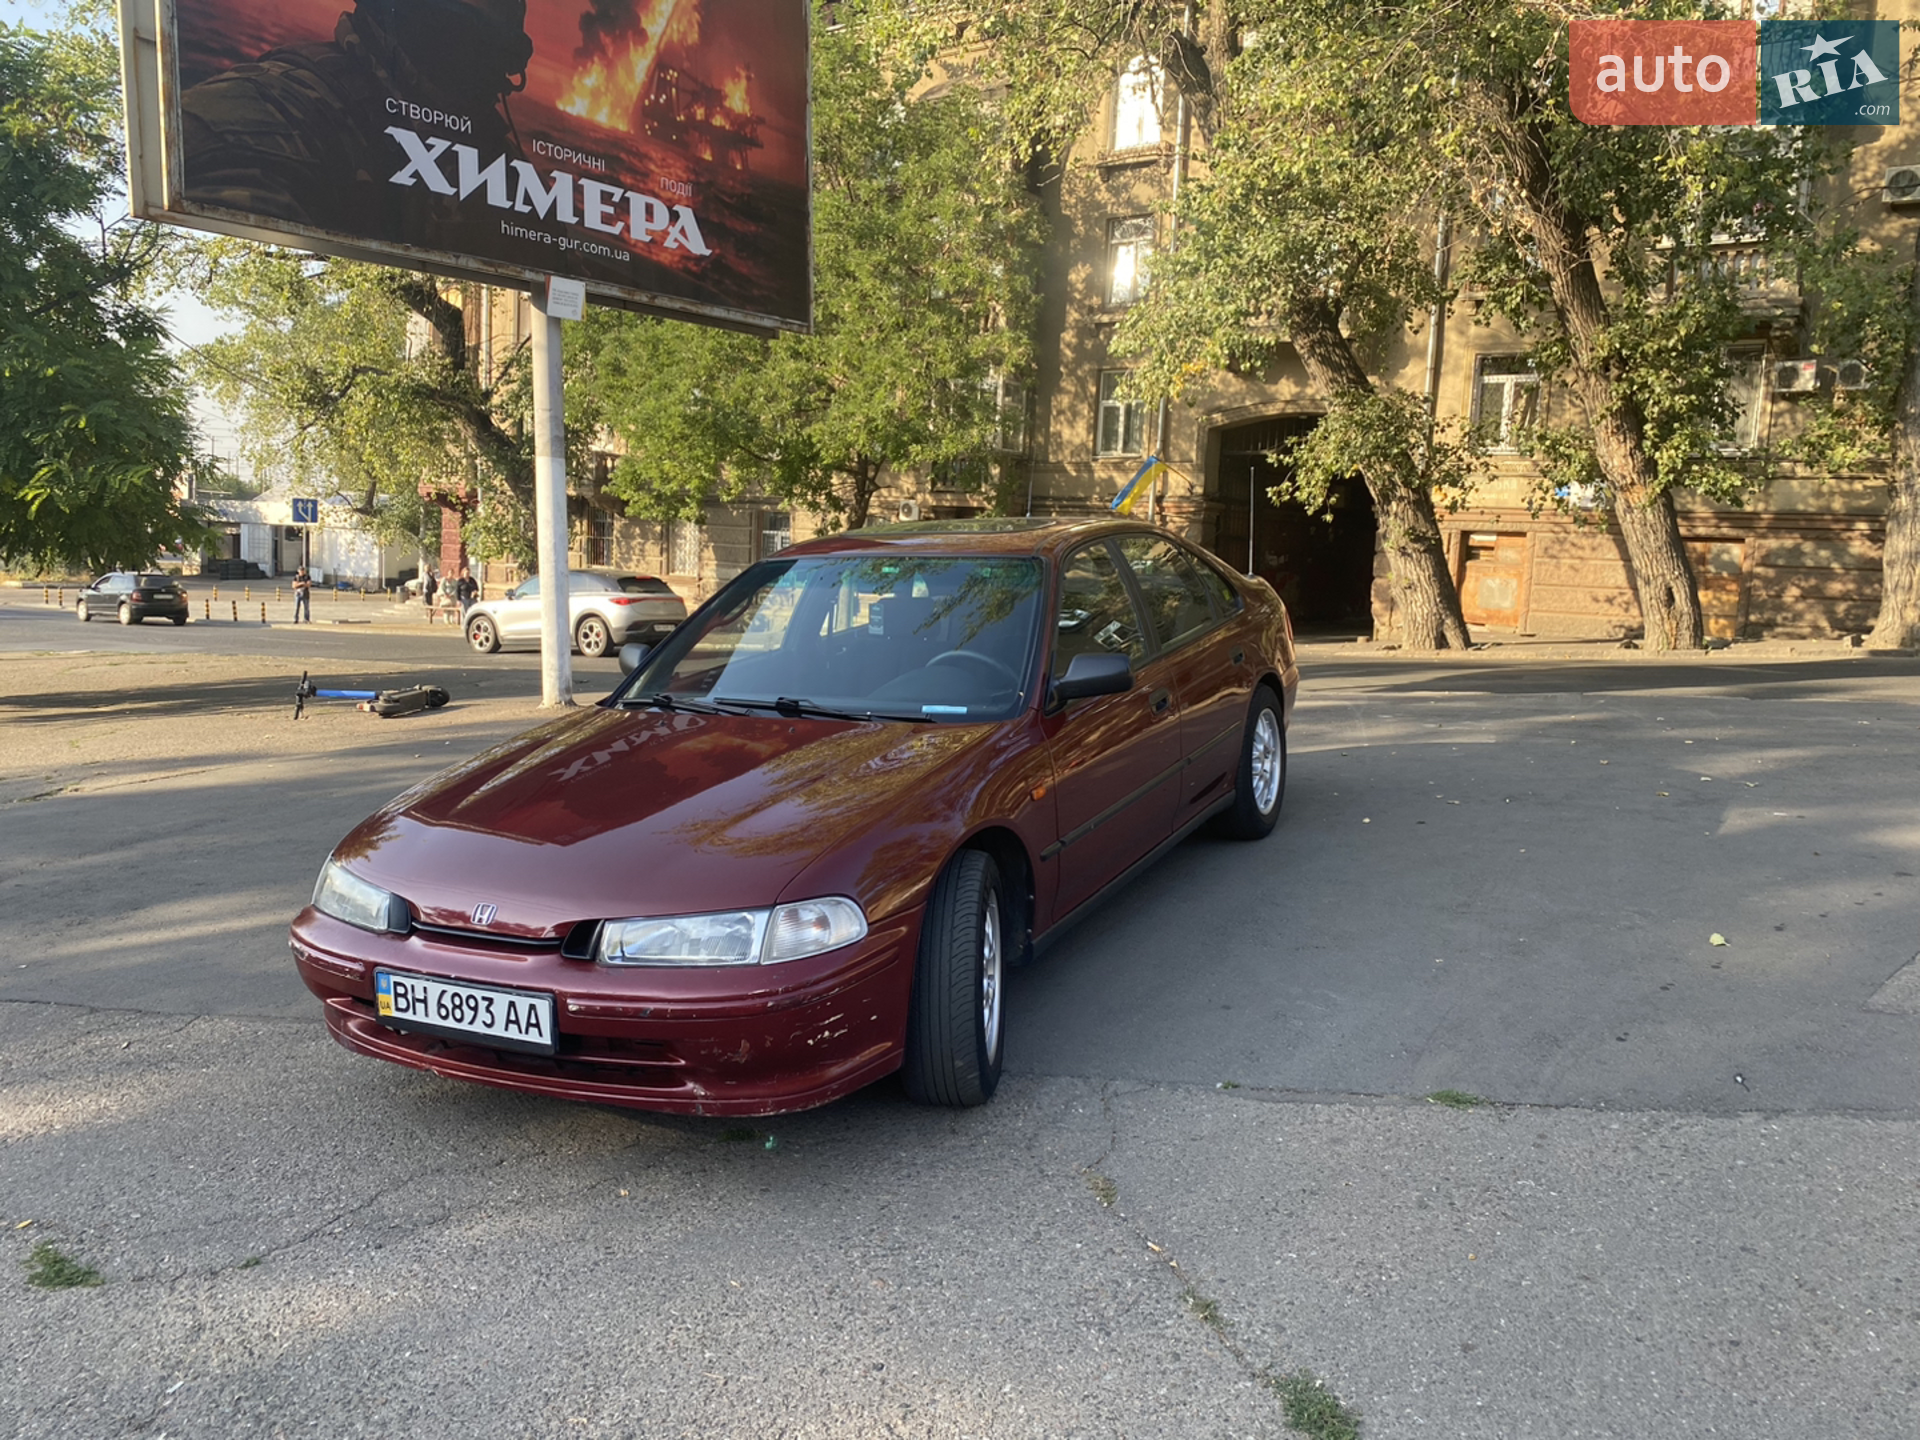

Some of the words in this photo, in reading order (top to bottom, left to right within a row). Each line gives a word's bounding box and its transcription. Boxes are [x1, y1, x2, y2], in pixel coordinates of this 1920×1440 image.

[385, 97, 472, 134] СТВОРЮЙ
[532, 139, 606, 172] ІСТОРИЧНІ
[384, 126, 713, 256] ХИМЕРА
[660, 176, 694, 198] ПОДІЇ
[501, 220, 631, 262] himera-gur.com.ua
[436, 989, 496, 1029] 6893
[504, 1000, 544, 1038] AA
